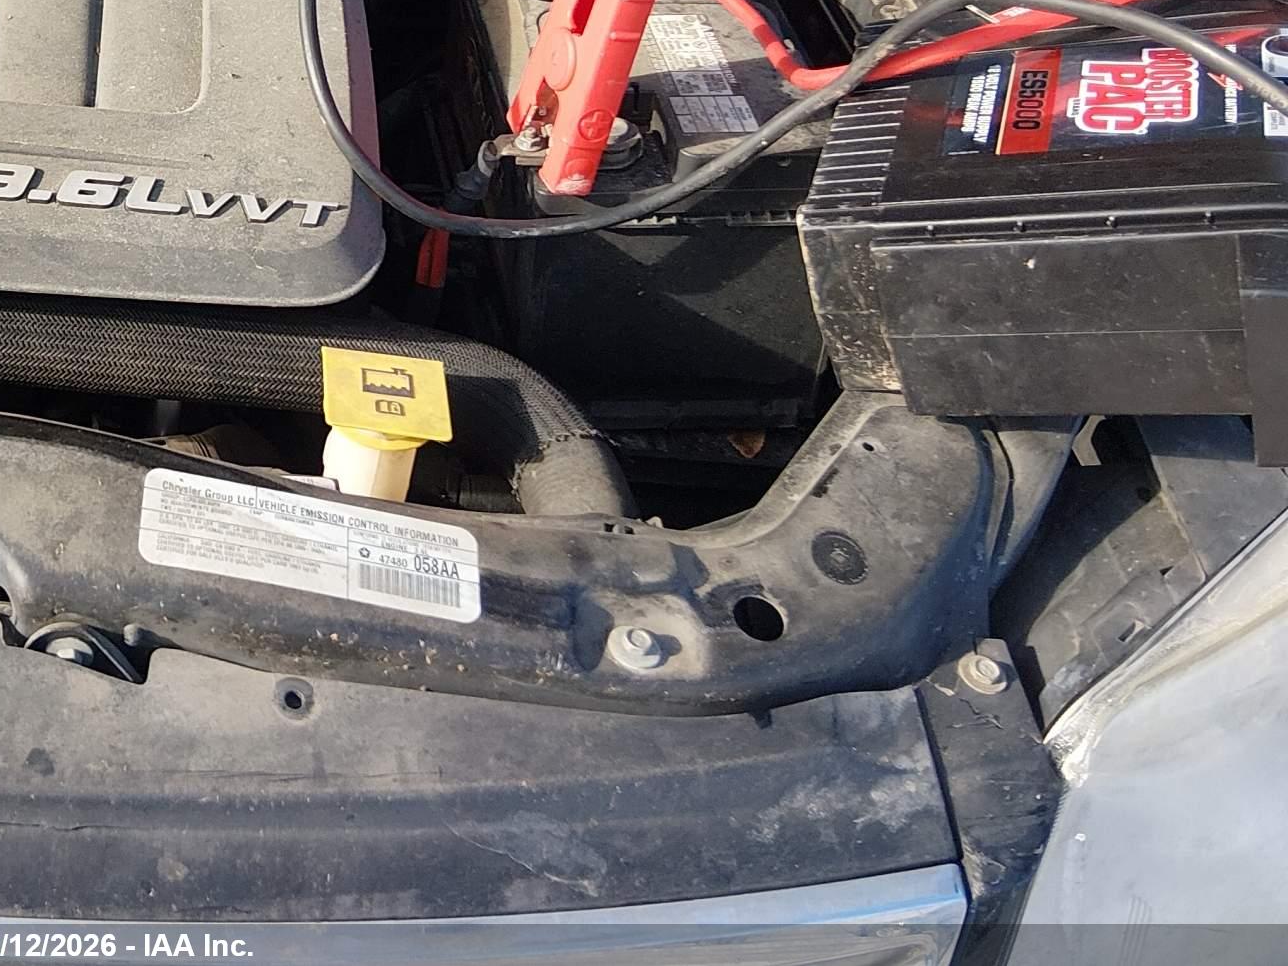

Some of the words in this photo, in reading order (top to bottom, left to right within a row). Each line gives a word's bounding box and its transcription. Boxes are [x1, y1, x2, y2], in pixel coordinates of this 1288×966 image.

[983, 73, 1000, 90] VOLT
[1144, 49, 1194, 121] BOOSTER
[965, 93, 983, 112] PEAK
[978, 90, 997, 115] POWER
[1012, 70, 1049, 130] ES5000
[1082, 62, 1148, 132] PAC
[960, 112, 978, 133] AMPS
[973, 115, 992, 143] SUPPLY
[162, 480, 202, 498] Chrysler
[204, 488, 234, 504] Group
[237, 495, 255, 507] LLC
[258, 498, 297, 516] VEHICLE
[300, 506, 345, 525] EMISSION
[348, 516, 390, 534] CONTROL
[394, 525, 460, 548] INFORMATION
[413, 553, 460, 580] 058AA
